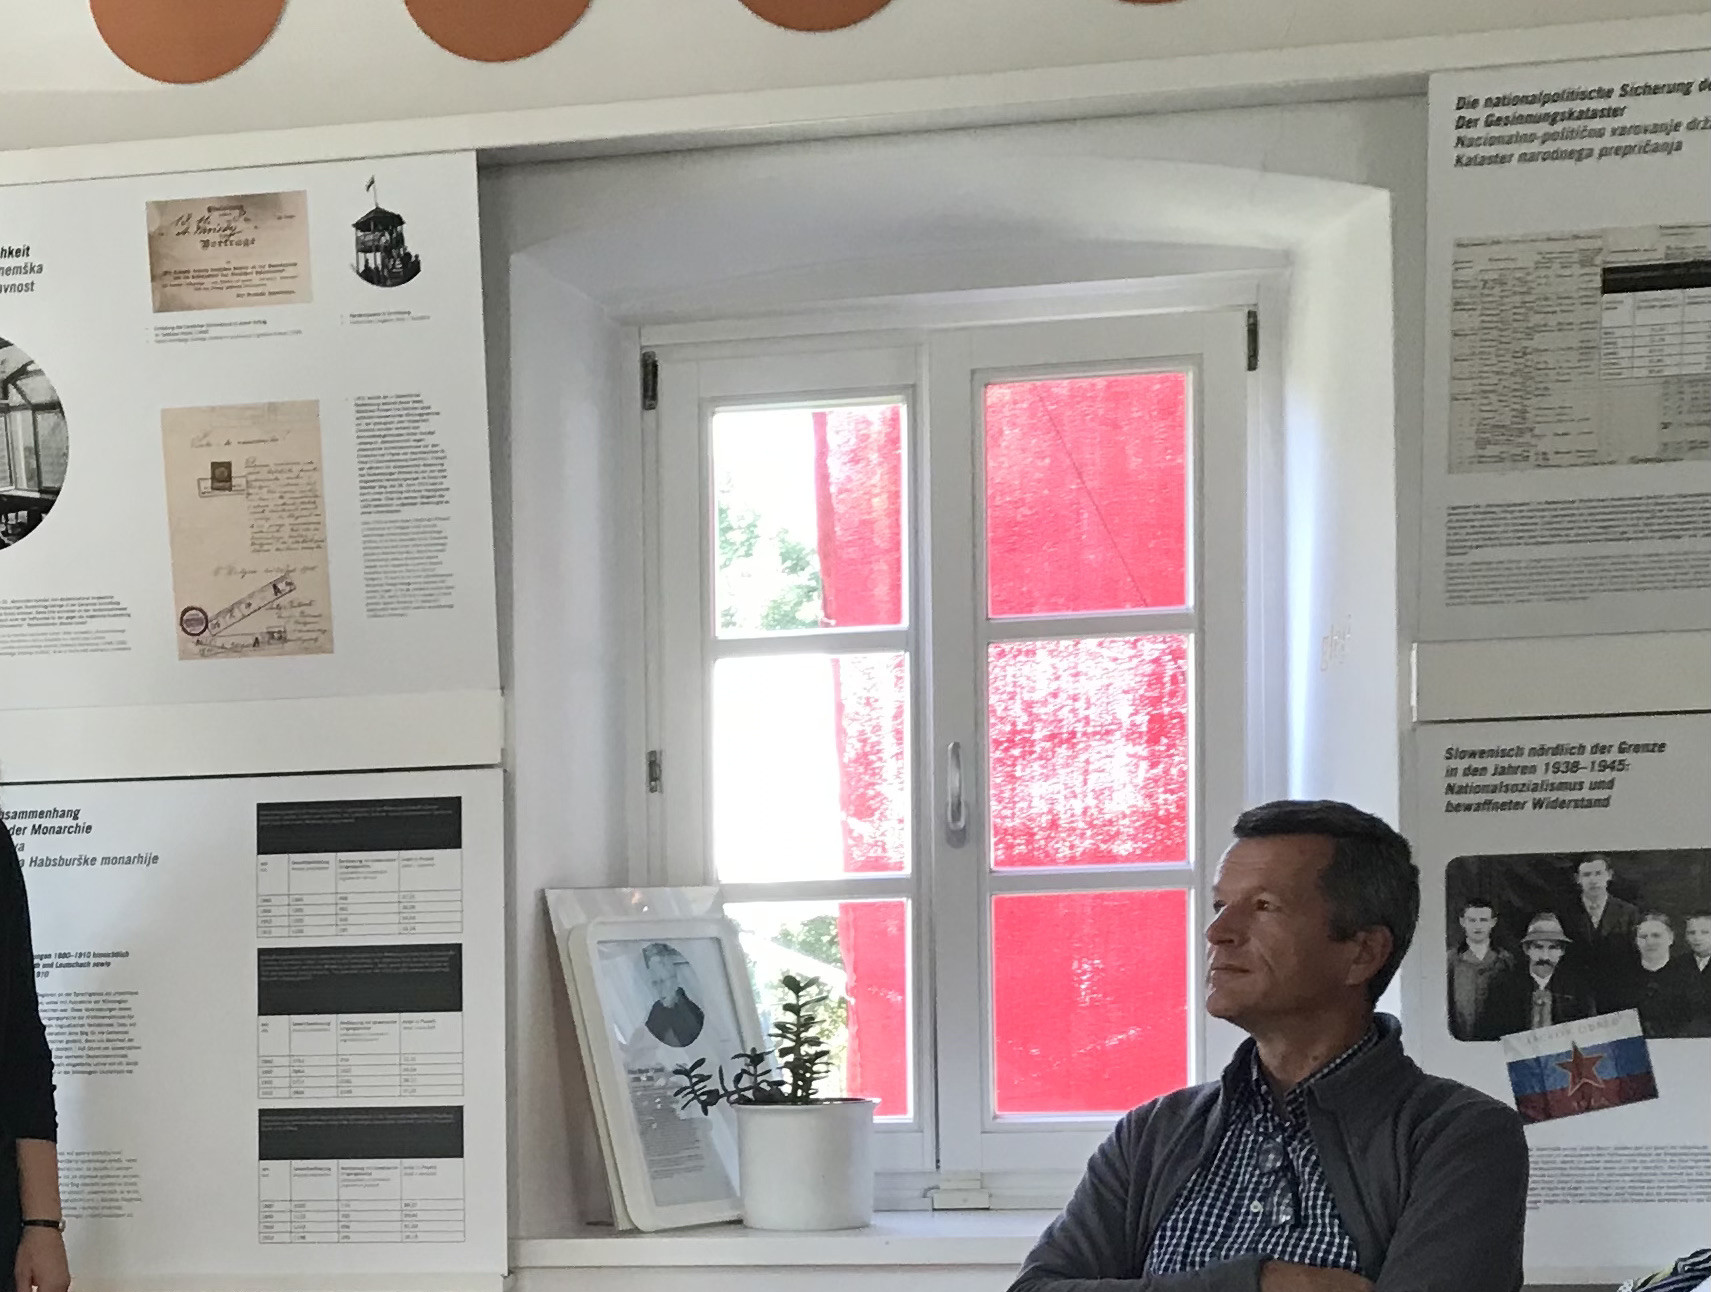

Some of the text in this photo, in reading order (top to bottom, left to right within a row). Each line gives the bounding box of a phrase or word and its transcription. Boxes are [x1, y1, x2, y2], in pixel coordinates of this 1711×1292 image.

[1455, 95, 1480, 110] Die
[1618, 81, 1695, 97] Sicherung
[1455, 115, 1480, 130] Der
[1445, 741, 1666, 760] Slowenisch nördlich der Grenze
[1445, 765, 1458, 777] in
[1462, 763, 1487, 777] den
[1491, 763, 1537, 776] Jahren
[1445, 777, 1616, 795] Nationalsozialismus und
[1445, 795, 1612, 812] bewaffneter Widerstand
[9, 822, 92, 836] der Monarchie
[29, 855, 97, 868] Habsburške
[100, 852, 159, 867] monarhije
